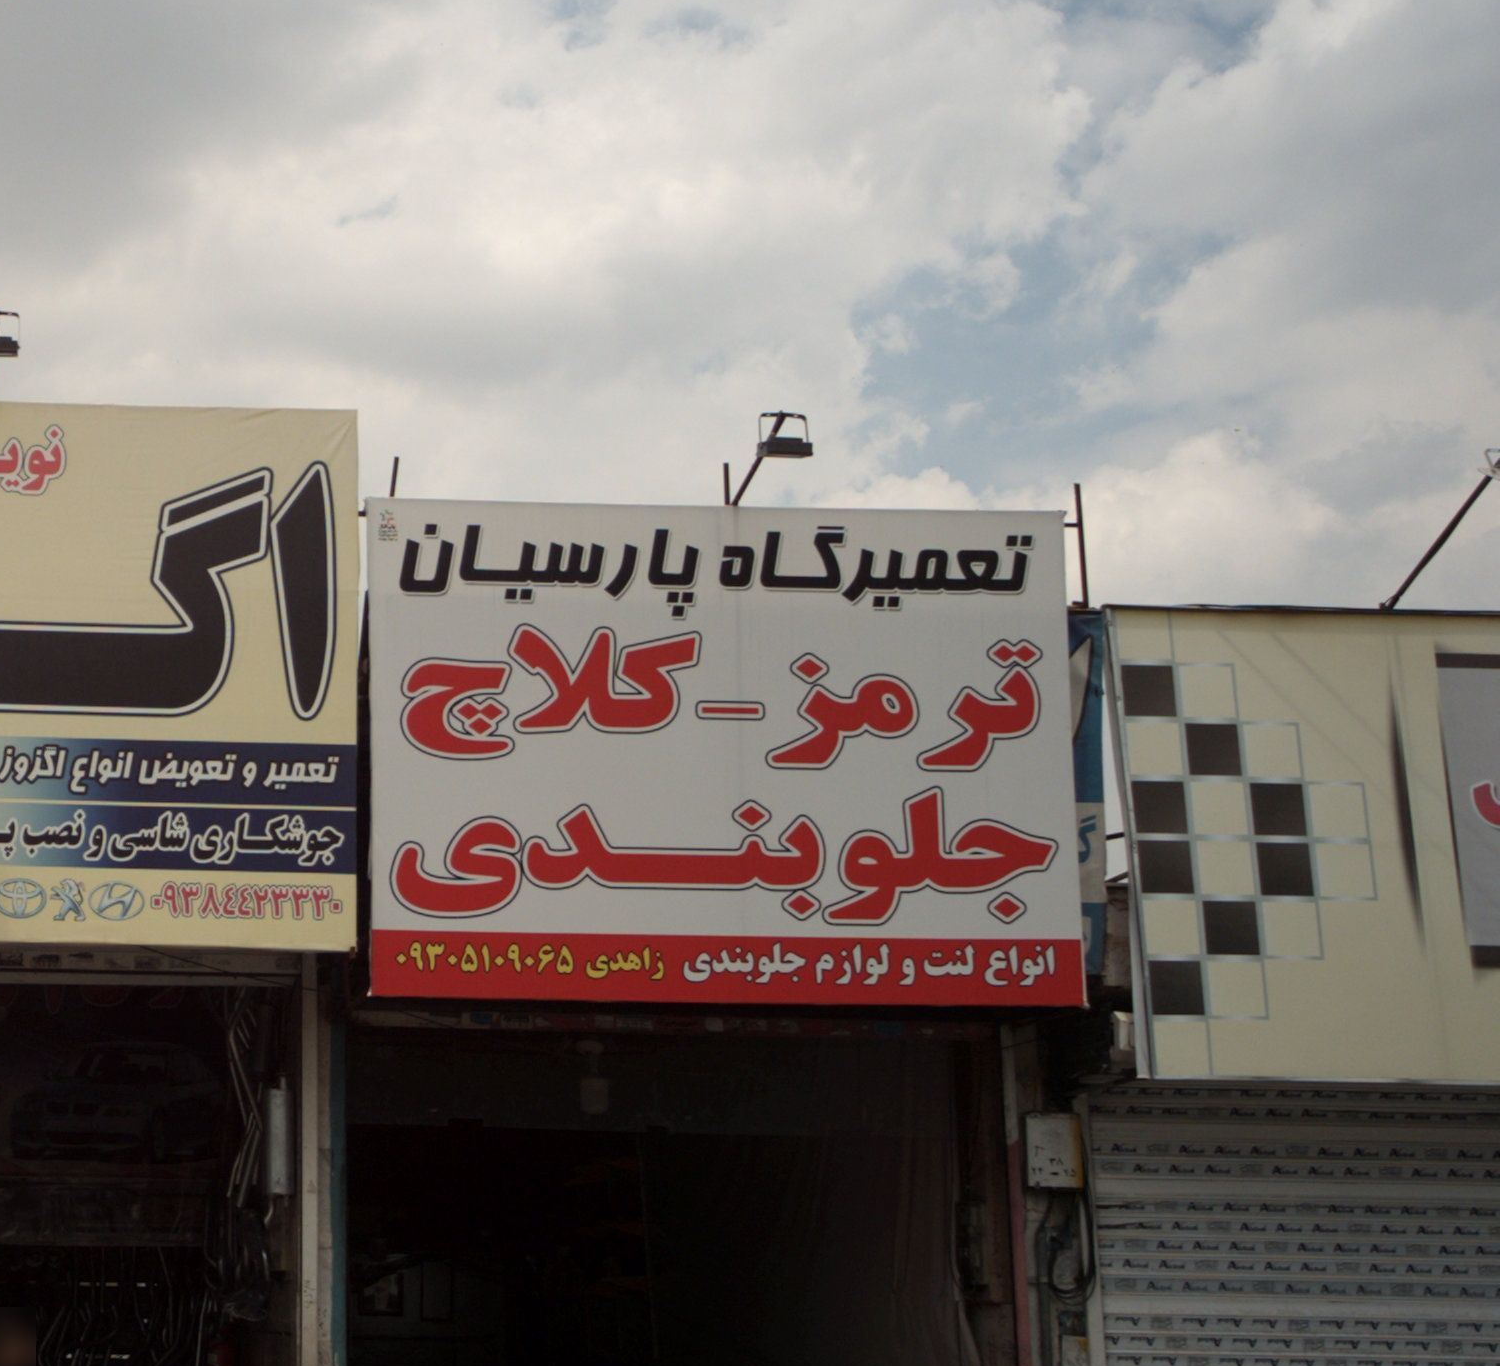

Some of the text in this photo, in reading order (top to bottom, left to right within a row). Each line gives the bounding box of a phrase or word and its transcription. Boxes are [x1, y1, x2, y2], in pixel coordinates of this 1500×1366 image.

[399, 523, 1035, 619] تعمیرگاه پارسیان
[401, 622, 703, 759] کلاچ
[765, 637, 1043, 772] ترمز
[69, 750, 133, 794] انواع
[139, 752, 238, 788] تعویض
[241, 761, 255, 788] و
[263, 754, 341, 792] تعمیر
[21, 807, 86, 858] نصب
[83, 824, 108, 862] و
[107, 809, 190, 862] شاسی
[190, 812, 345, 867] جوشکاری
[391, 786, 1059, 926] جلوبندی
[585, 945, 666, 981] زاهدی
[682, 941, 808, 985] جلوبندی
[814, 942, 892, 987] لوازم
[899, 956, 917, 987] و
[922, 943, 976, 978] لنت
[983, 944, 1057, 988] انواع
